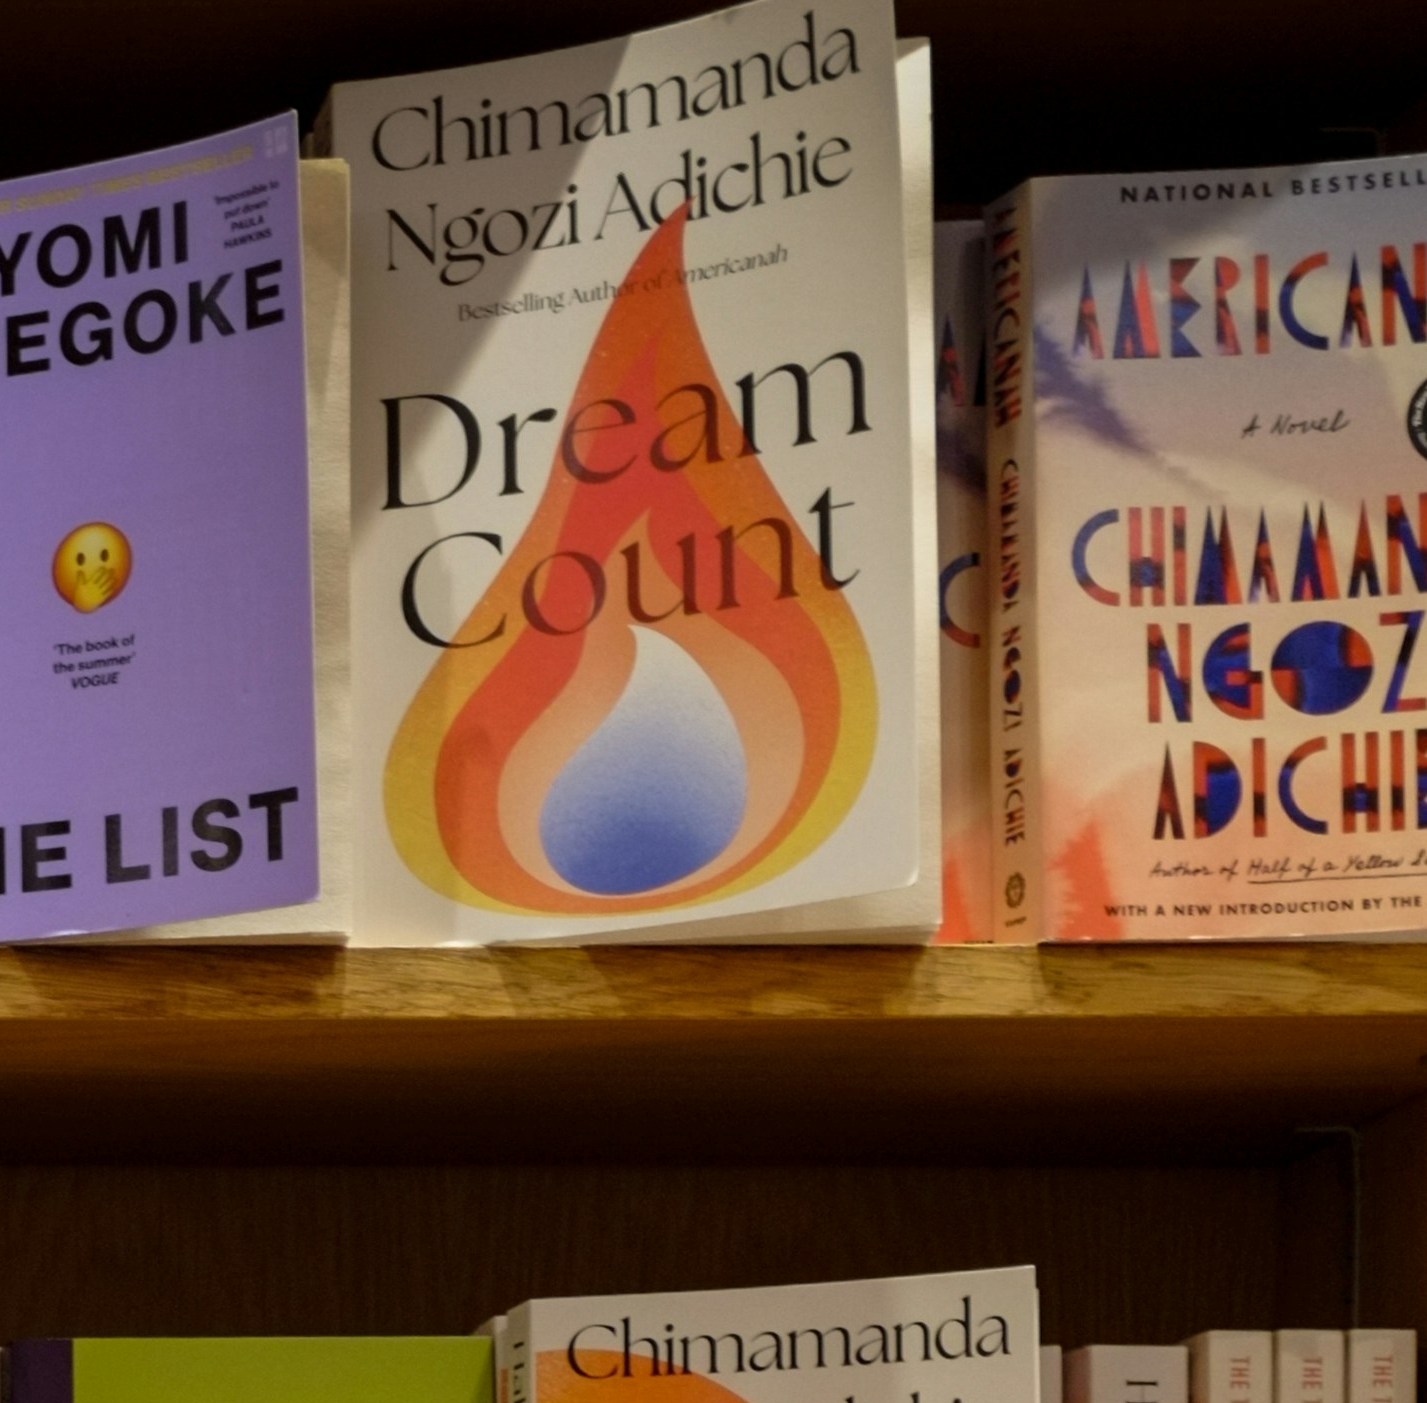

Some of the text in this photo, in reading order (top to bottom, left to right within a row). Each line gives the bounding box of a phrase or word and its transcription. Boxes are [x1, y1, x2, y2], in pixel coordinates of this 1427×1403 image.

[372, 10, 861, 172] Chimamanda
[385, 131, 854, 287] Ngozi Adichie
[1121, 181, 1275, 204] NATIONAL
[380, 351, 873, 511] Dream
[1271, 410, 1352, 437] Novel
[400, 487, 863, 650] Count
[54, 659, 76, 674] the
[72, 672, 120, 689] VOGUE
[84, 637, 119, 653] book
[122, 634, 136, 648] of
[106, 787, 300, 884] LIST
[567, 1296, 1013, 1380] Chimamanda
